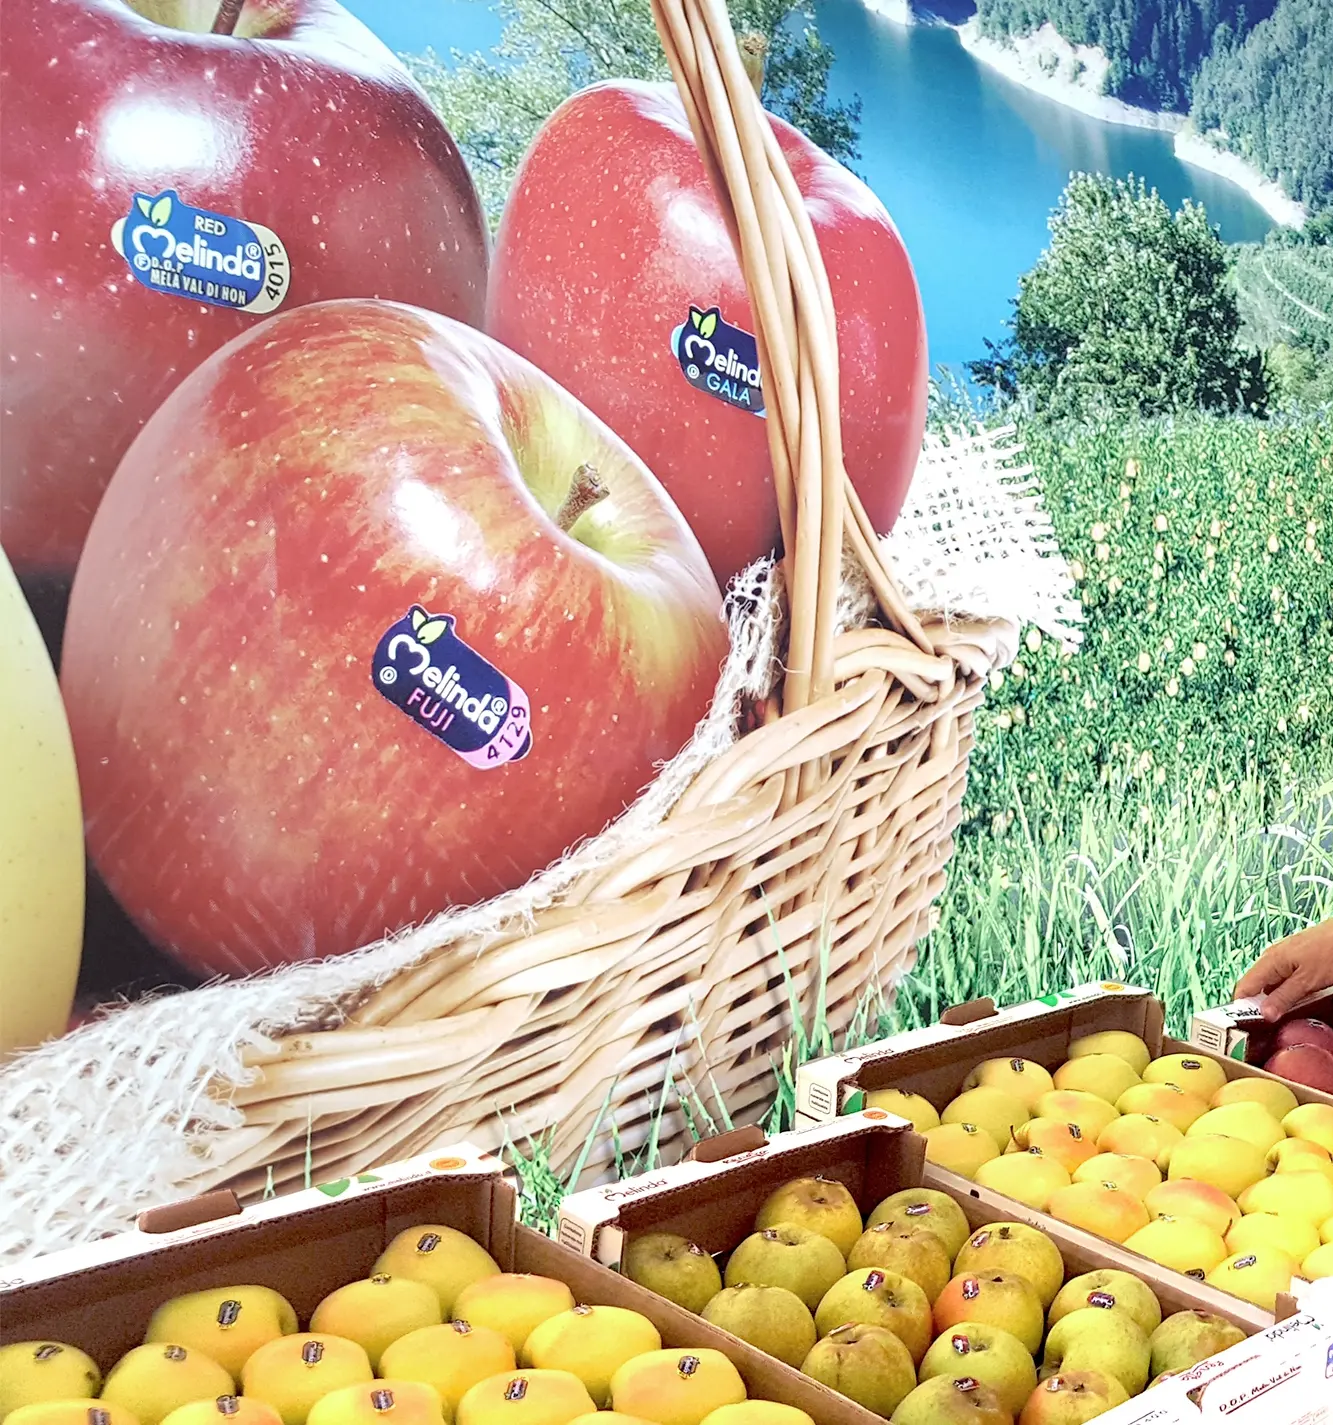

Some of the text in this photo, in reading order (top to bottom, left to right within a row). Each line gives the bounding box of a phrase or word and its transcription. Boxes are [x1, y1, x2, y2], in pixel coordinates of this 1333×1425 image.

[132, 224, 260, 281] Melinda
[194, 215, 227, 237] RED
[150, 268, 180, 289] MELA
[183, 276, 204, 295] VAL
[206, 282, 219, 298] DI
[265, 243, 284, 301] 4015
[685, 334, 763, 388] Melind
[707, 373, 750, 405] GALA
[388, 634, 500, 734] Melinda
[407, 687, 455, 731] FUJI
[487, 706, 527, 760] 4129
